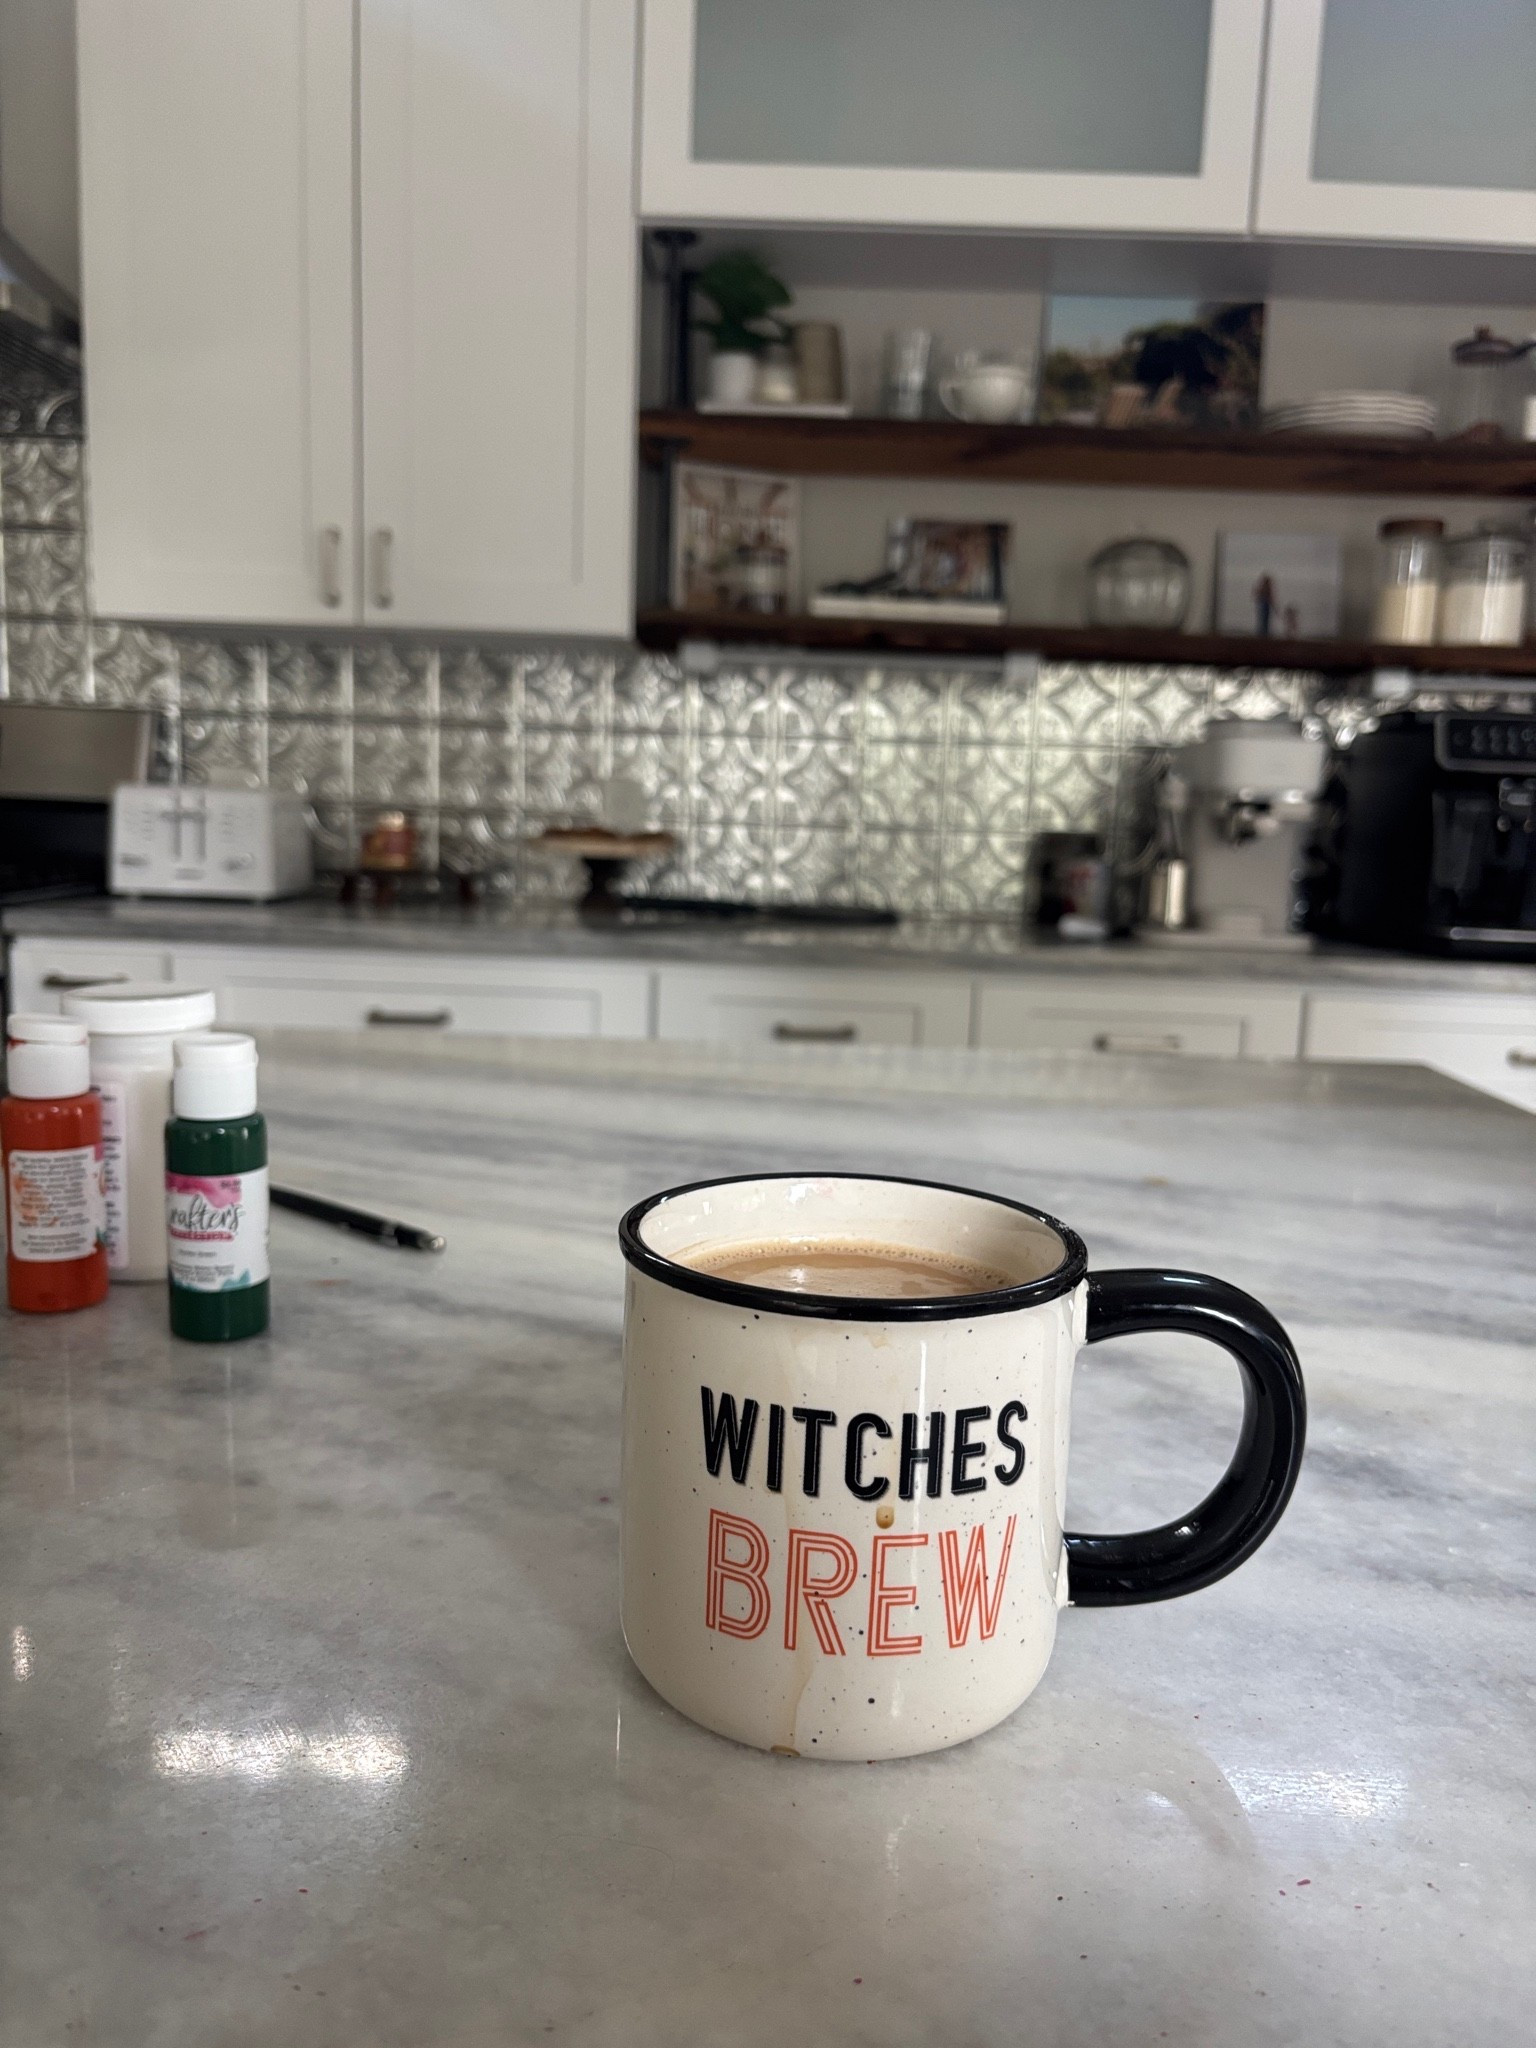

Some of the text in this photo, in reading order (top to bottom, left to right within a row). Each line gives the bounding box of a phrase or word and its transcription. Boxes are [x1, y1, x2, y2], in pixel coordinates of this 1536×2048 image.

[169, 1193, 244, 1234] rafter's
[701, 1385, 1028, 1500] WITCHES
[706, 1508, 1017, 1657] BREW
